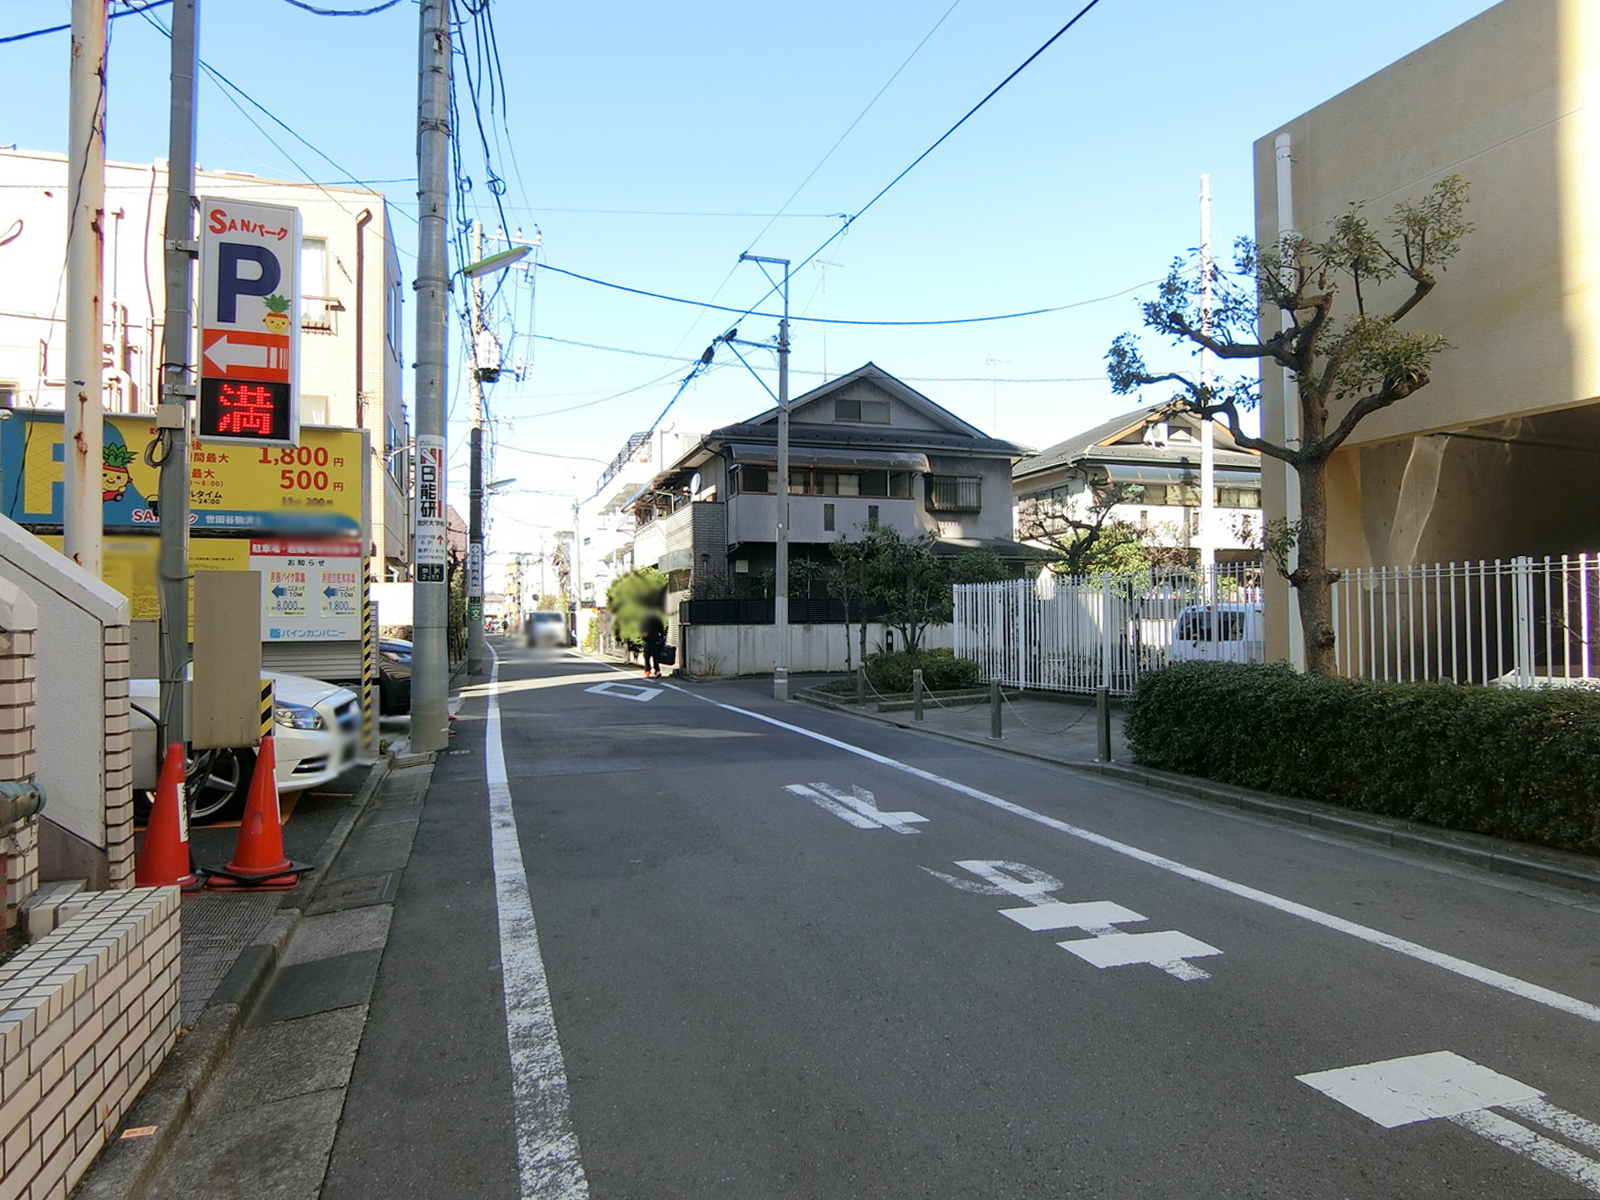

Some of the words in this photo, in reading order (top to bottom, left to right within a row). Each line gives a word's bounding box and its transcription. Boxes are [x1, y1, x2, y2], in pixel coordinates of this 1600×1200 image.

[208, 208, 289, 242] SANパーク
[216, 241, 281, 324] P
[217, 383, 275, 435] 満
[190, 452, 230, 464] 間最大
[420, 466, 437, 518] 日能研
[287, 559, 326, 567] お知らせ
[281, 628, 347, 638] パインカンパニー
